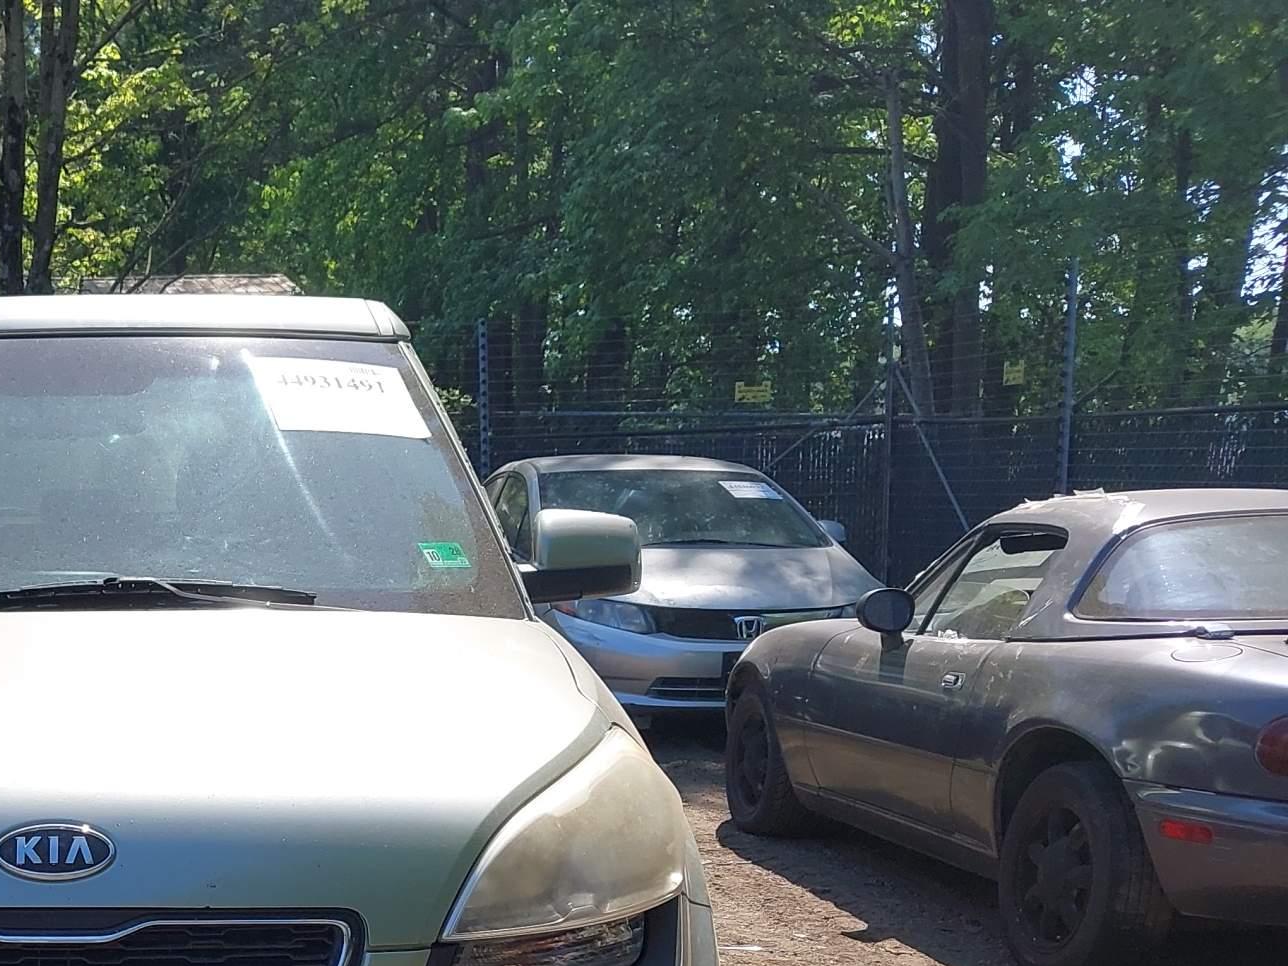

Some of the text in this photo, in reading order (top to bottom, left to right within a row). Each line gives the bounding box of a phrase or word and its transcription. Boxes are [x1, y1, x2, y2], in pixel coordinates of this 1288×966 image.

[277, 374, 385, 393] 44931491
[426, 550, 441, 562] 10
[15, 835, 94, 865] KIA
